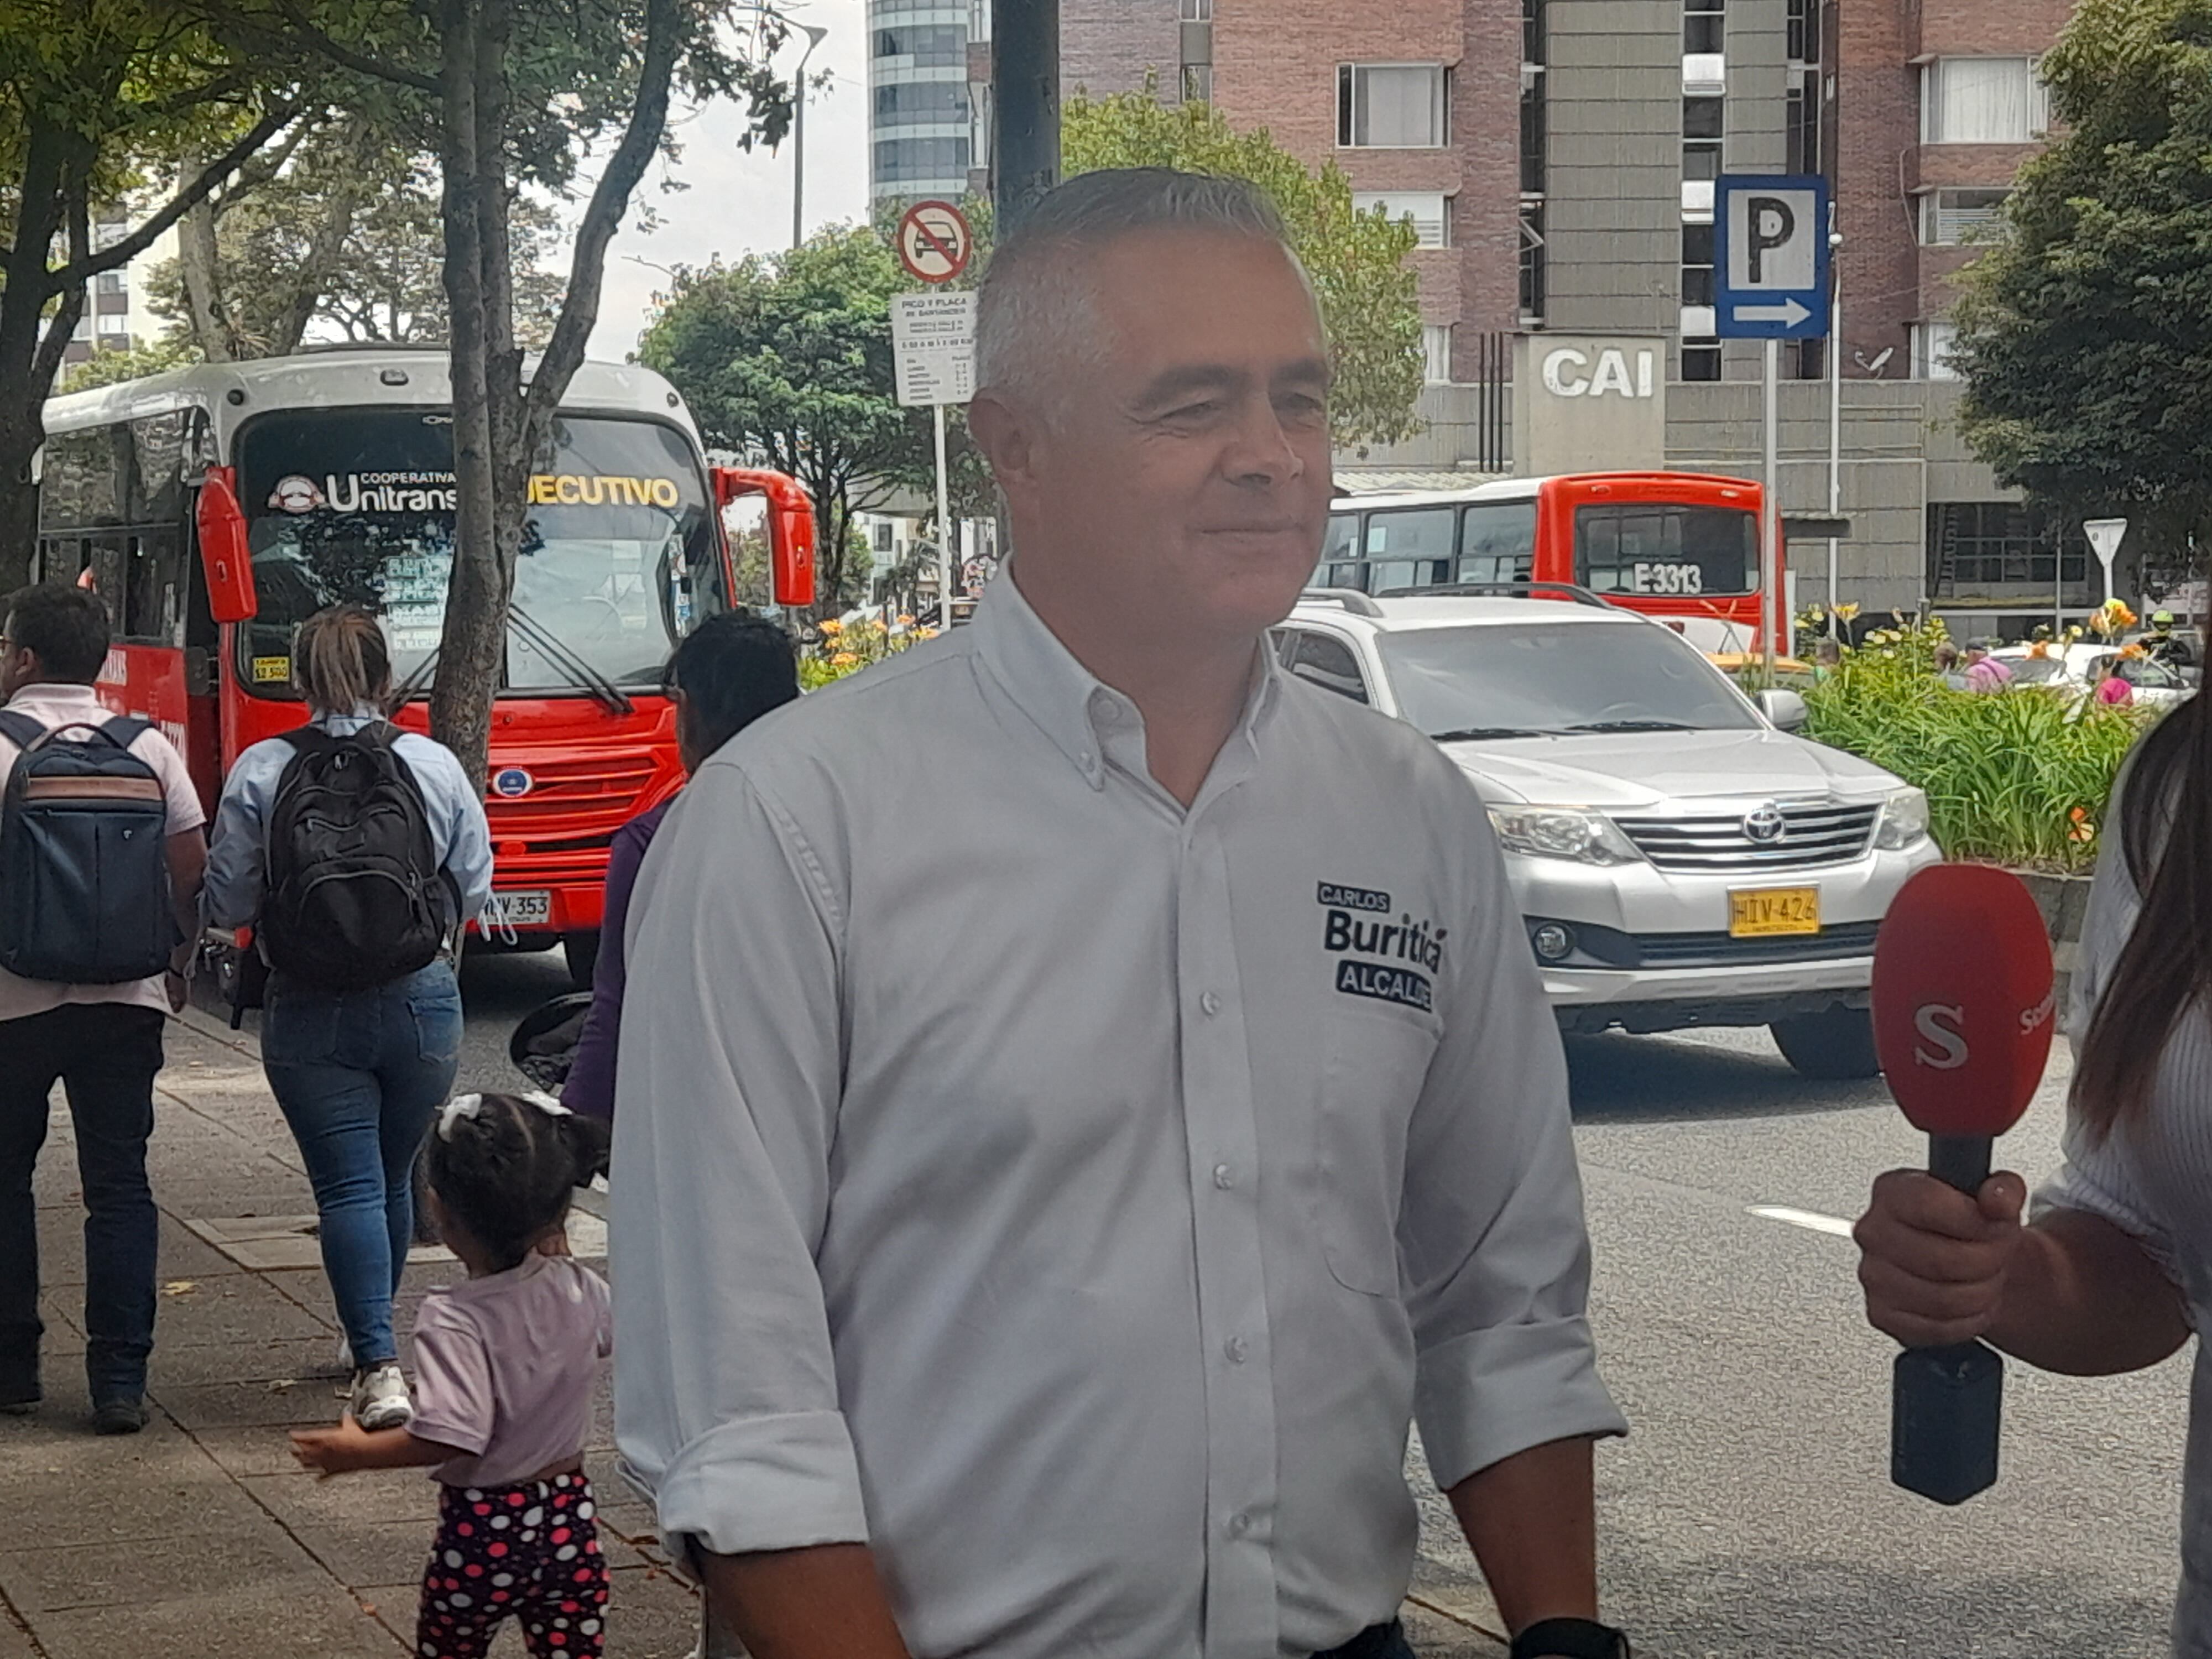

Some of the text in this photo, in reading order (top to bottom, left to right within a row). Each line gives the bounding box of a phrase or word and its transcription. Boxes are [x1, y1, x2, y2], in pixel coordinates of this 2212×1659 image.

[1748, 197, 1795, 284] P
[1542, 348, 1653, 397] CAI
[326, 473, 458, 512] Unitrans
[360, 472, 457, 484] COOPERATIVA
[1320, 885, 1388, 911] CARLOS
[1913, 1003, 1969, 1070] S
